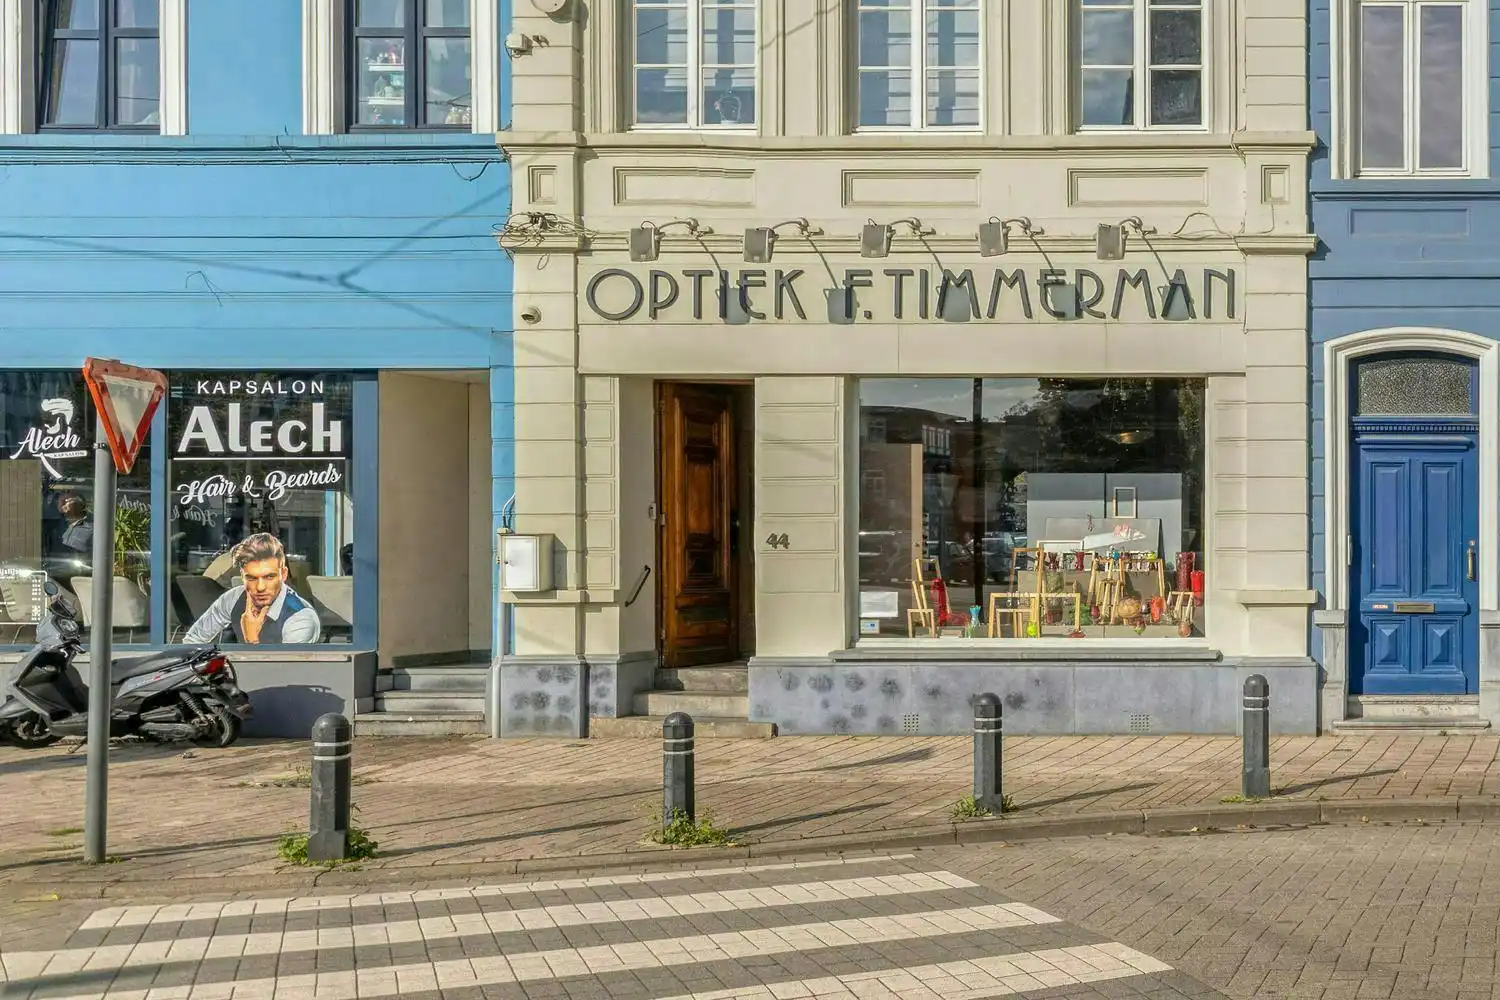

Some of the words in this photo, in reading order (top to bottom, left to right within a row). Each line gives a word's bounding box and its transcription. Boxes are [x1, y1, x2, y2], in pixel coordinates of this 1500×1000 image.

[585, 268, 807, 321] OPTIEK
[197, 380, 324, 394] KAPSALON
[10, 427, 80, 459] Alech
[177, 474, 237, 504] Hair
[242, 475, 260, 497] &
[264, 463, 342, 500] Beards
[766, 533, 790, 549] 44
